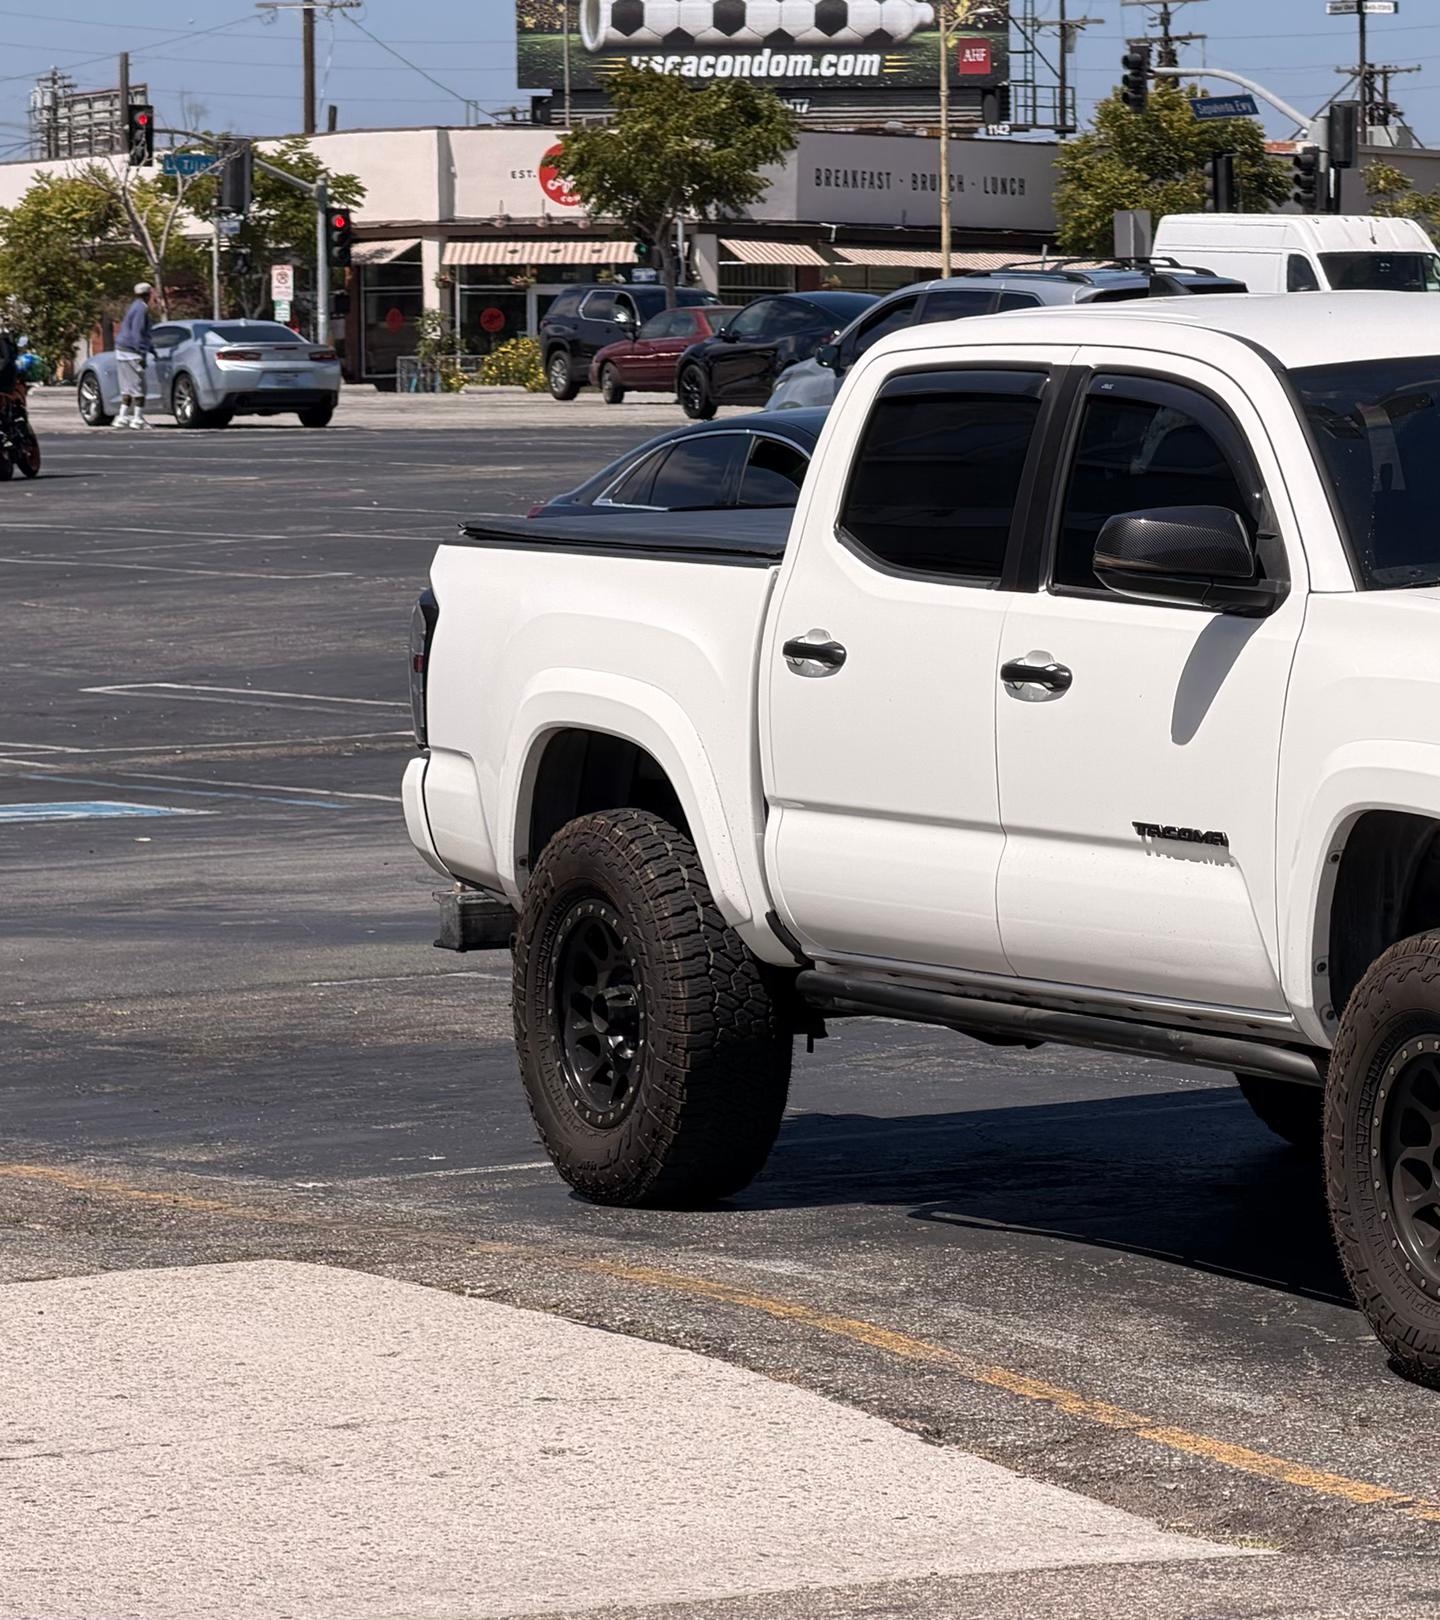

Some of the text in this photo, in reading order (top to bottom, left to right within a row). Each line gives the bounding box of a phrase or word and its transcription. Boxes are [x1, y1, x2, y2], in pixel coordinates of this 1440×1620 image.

[963, 48, 986, 62] AHF
[511, 170, 537, 179] EST.
[814, 168, 892, 190] BREAKFAST
[984, 176, 1026, 196] LUNCH
[1132, 821, 1230, 848] TACOMA
